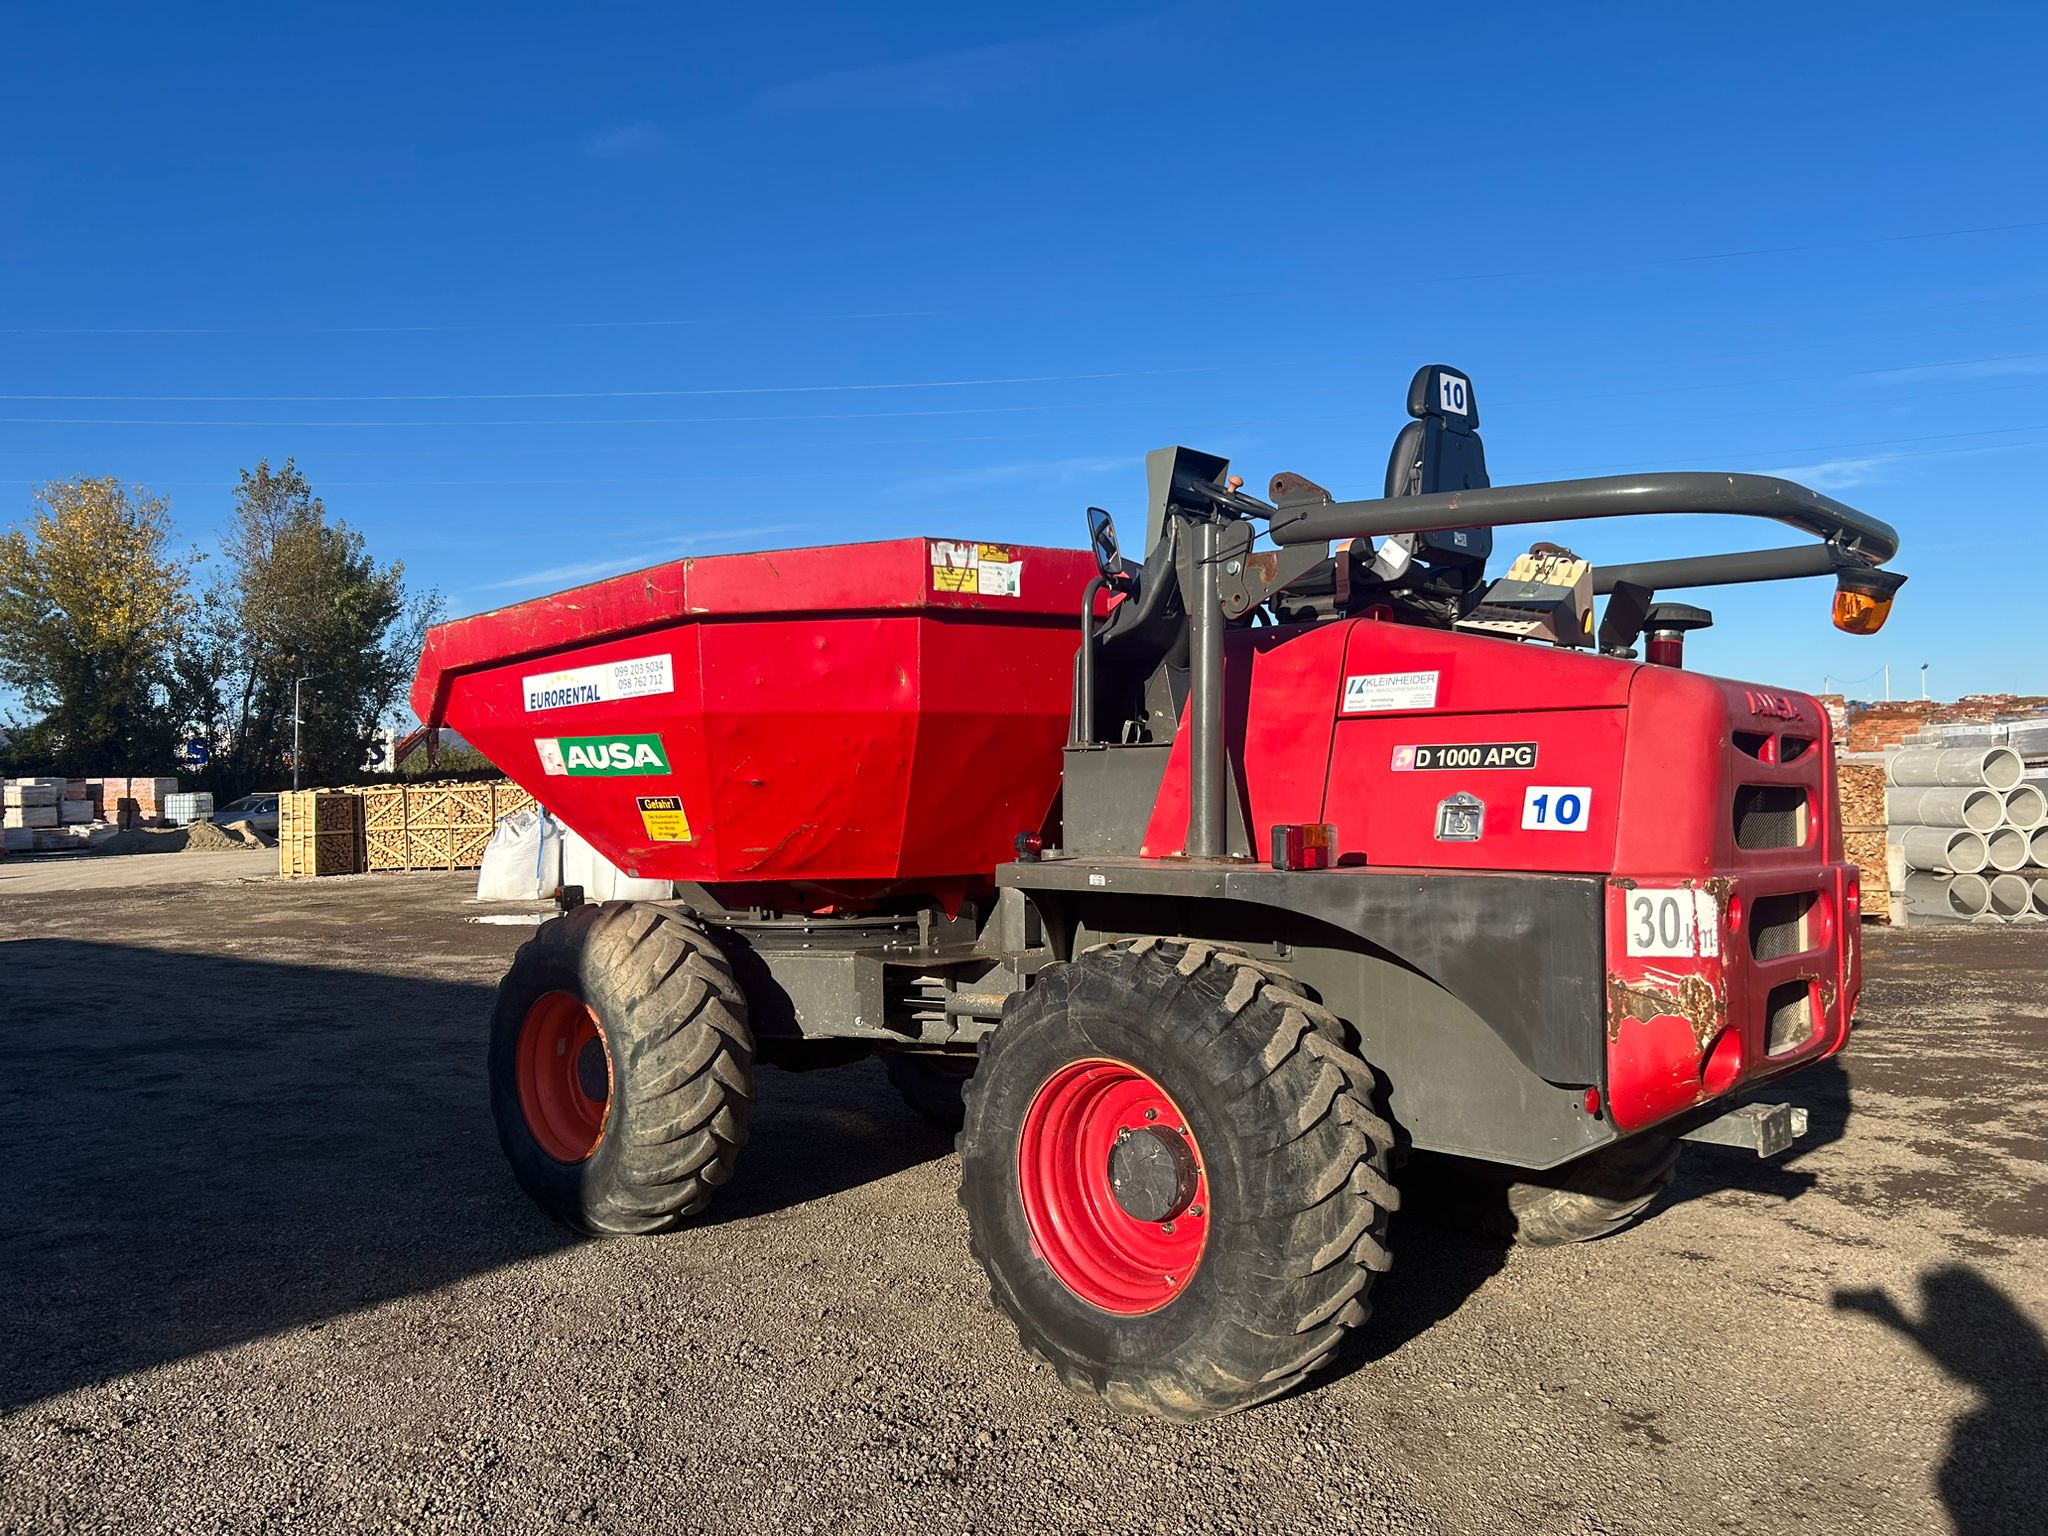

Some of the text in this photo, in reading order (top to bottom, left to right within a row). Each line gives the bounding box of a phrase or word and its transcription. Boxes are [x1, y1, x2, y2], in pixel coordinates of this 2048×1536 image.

[1443, 380, 1465, 410] 10
[614, 660, 664, 678] 099 203 5034
[1366, 674, 1435, 687] KLEINHEIDER
[617, 673, 663, 690] 098 762 712
[530, 684, 601, 709] EURORENTAL
[567, 743, 665, 770] AUSA
[1415, 746, 1532, 767] D 1000 APG
[644, 799, 675, 809] Gefahr!
[1531, 793, 1582, 825] 10
[1633, 896, 1681, 949] 30
